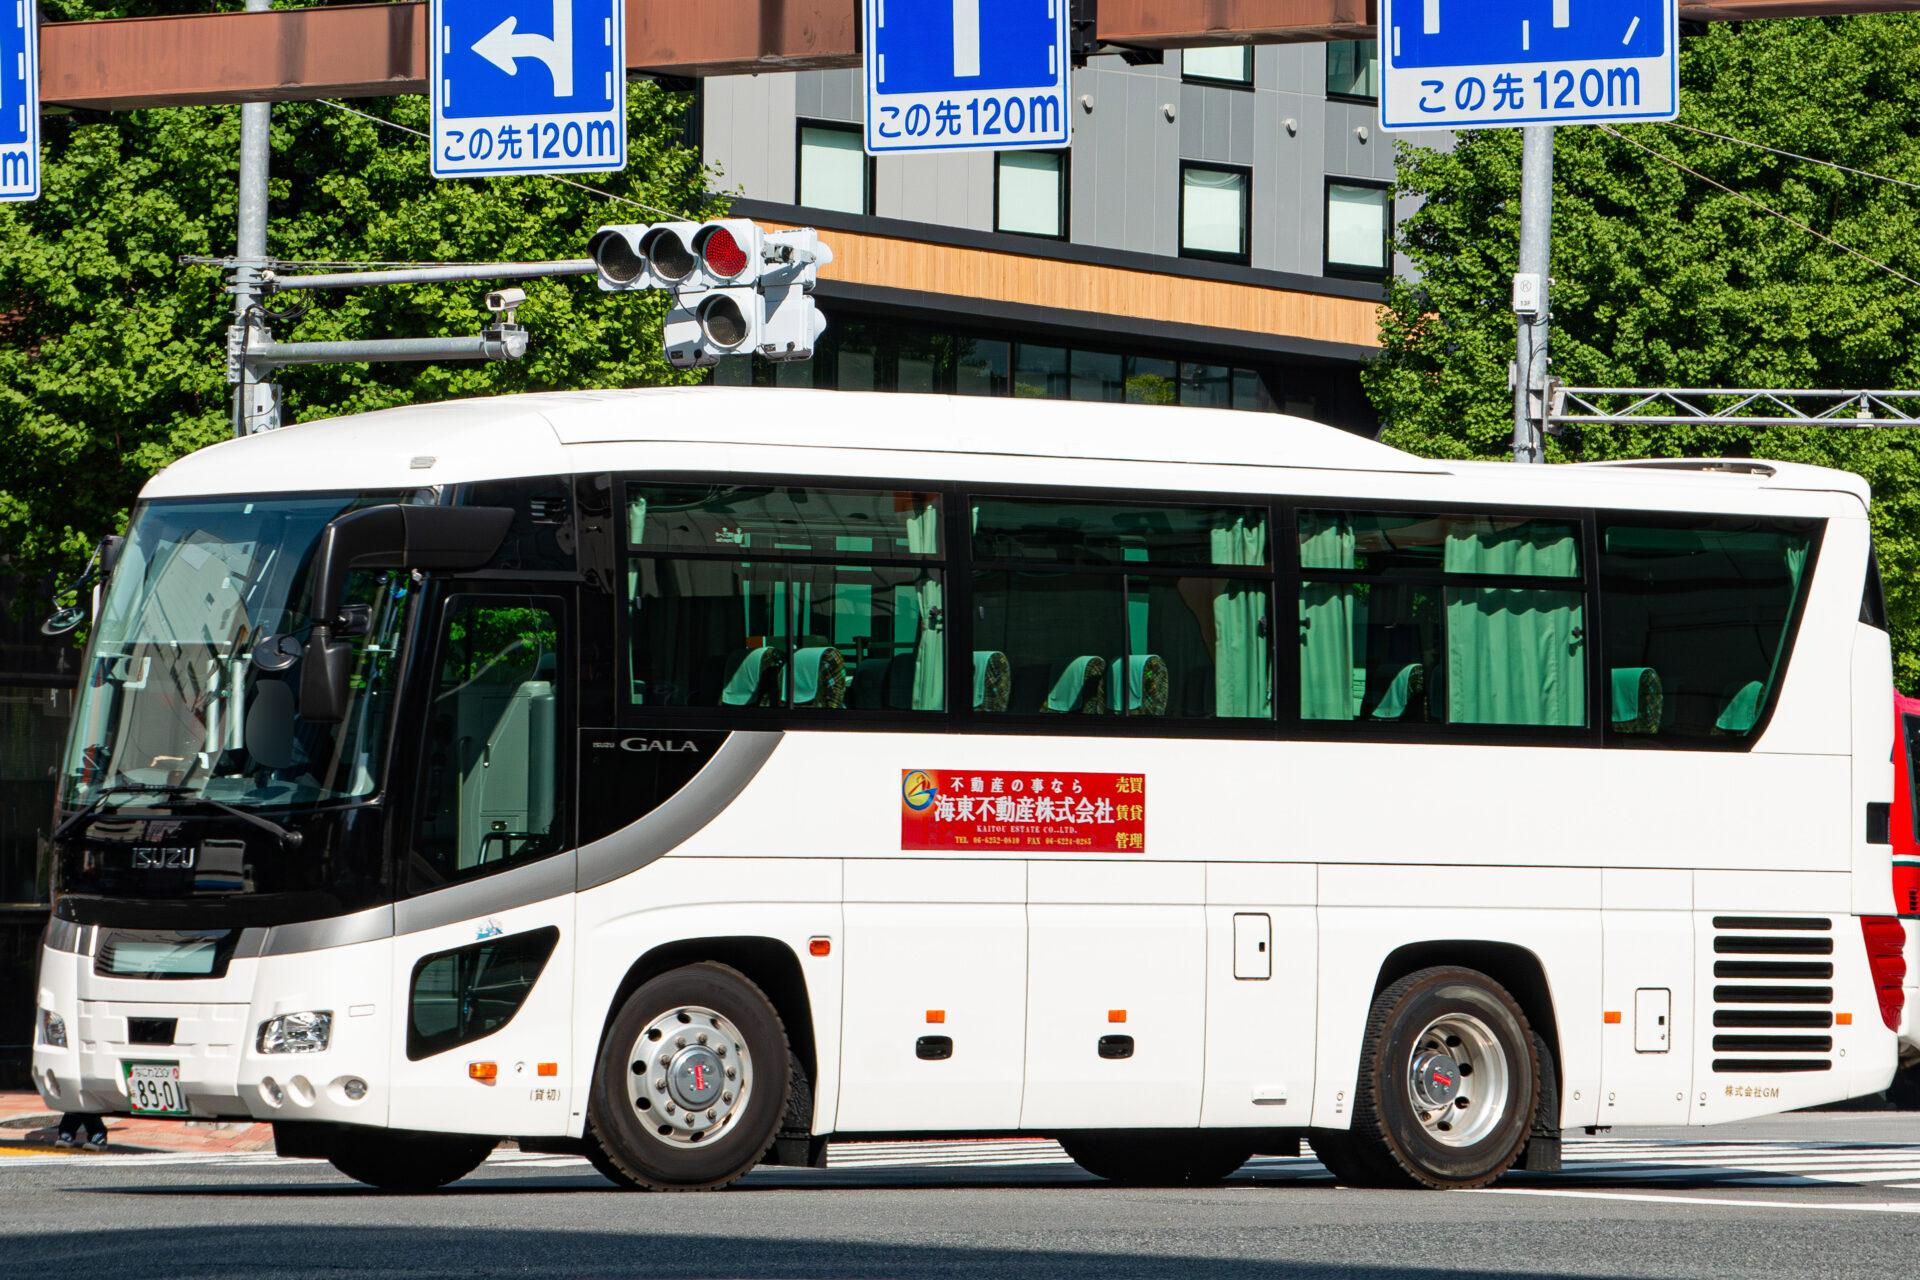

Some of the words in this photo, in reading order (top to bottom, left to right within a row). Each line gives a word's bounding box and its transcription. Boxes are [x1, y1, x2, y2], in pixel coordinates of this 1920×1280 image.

[1419, 66, 1640, 113] この先120m
[879, 94, 1060, 138] この先120m
[444, 120, 615, 161] この先120m
[2, 151, 29, 187] m
[620, 737, 699, 752] GALA
[950, 776, 1083, 794] 不動産の事なら
[1115, 776, 1143, 794] 売買
[934, 794, 1115, 824] 海東不動産株式会社
[1115, 804, 1143, 821] 賃貸
[1010, 825, 1040, 833] ESTATE
[954, 836, 969, 844] TEL
[1027, 836, 1041, 845] FAX
[1115, 832, 1143, 849] 管理
[132, 847, 195, 869] ISUZU
